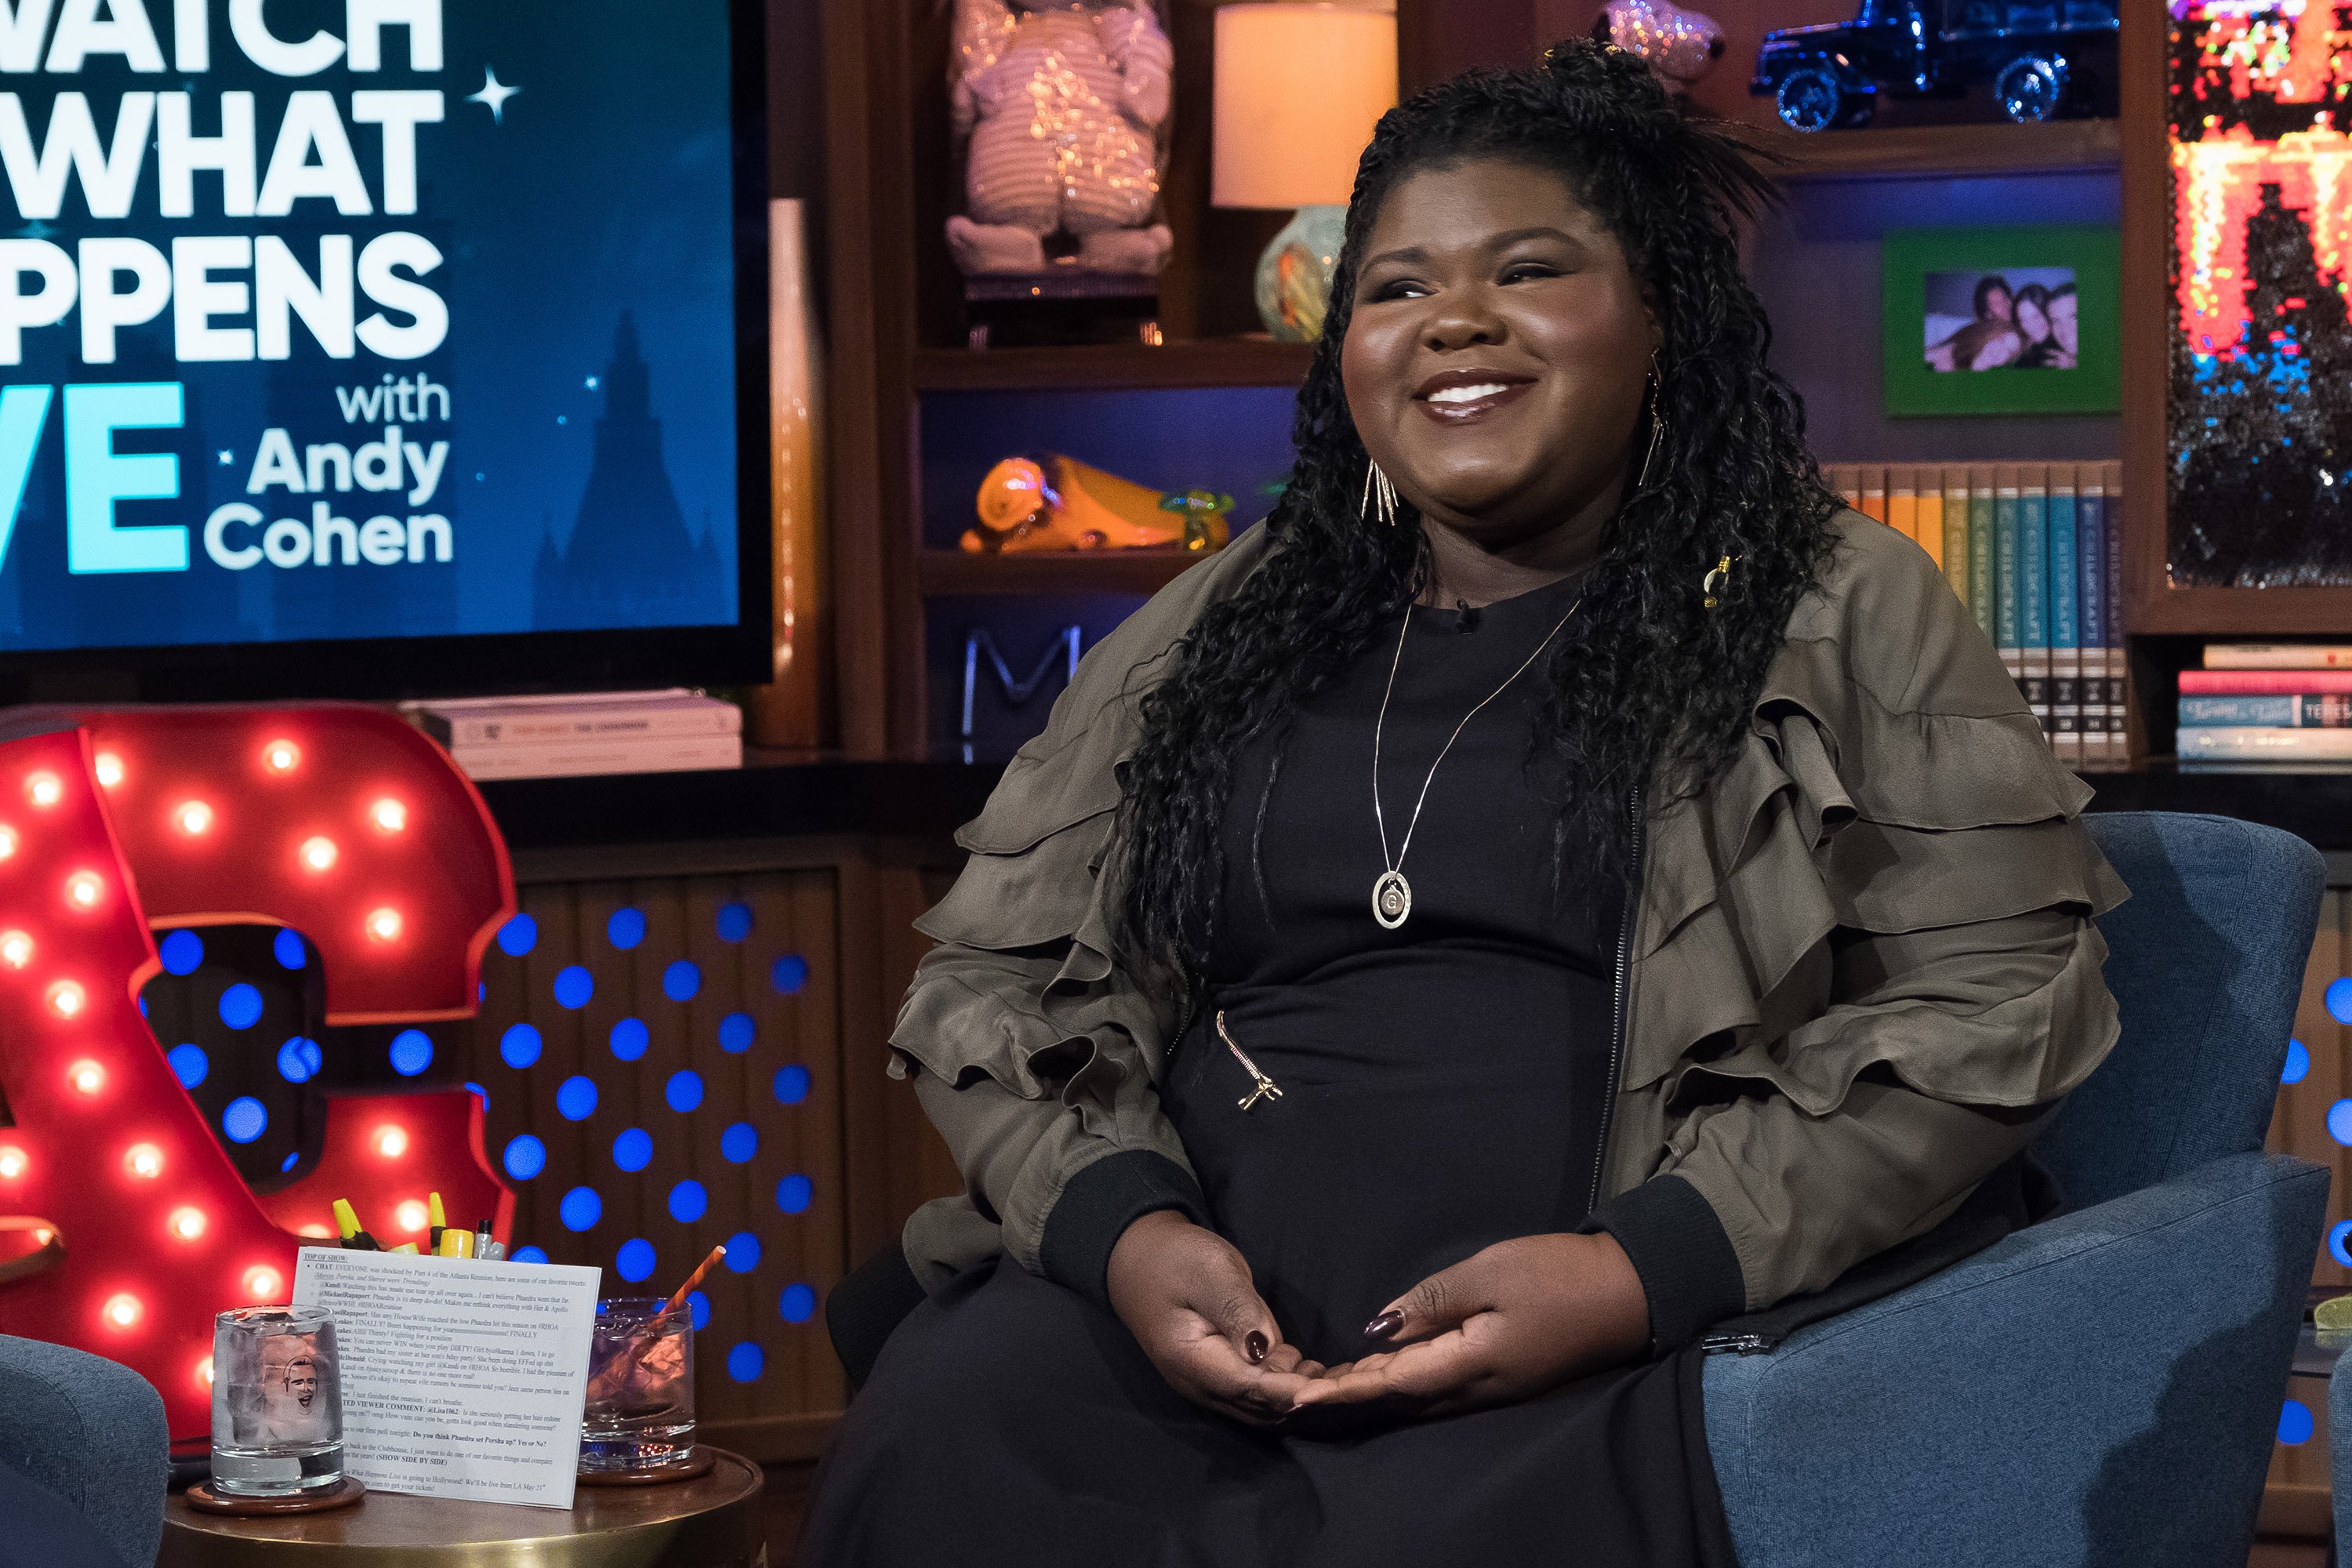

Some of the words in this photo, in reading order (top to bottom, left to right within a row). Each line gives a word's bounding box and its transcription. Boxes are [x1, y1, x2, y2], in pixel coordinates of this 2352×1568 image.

[0, 89, 445, 219] WHAT
[336, 372, 450, 423] with
[245, 424, 449, 506] Andy
[203, 501, 453, 570] Cohen
